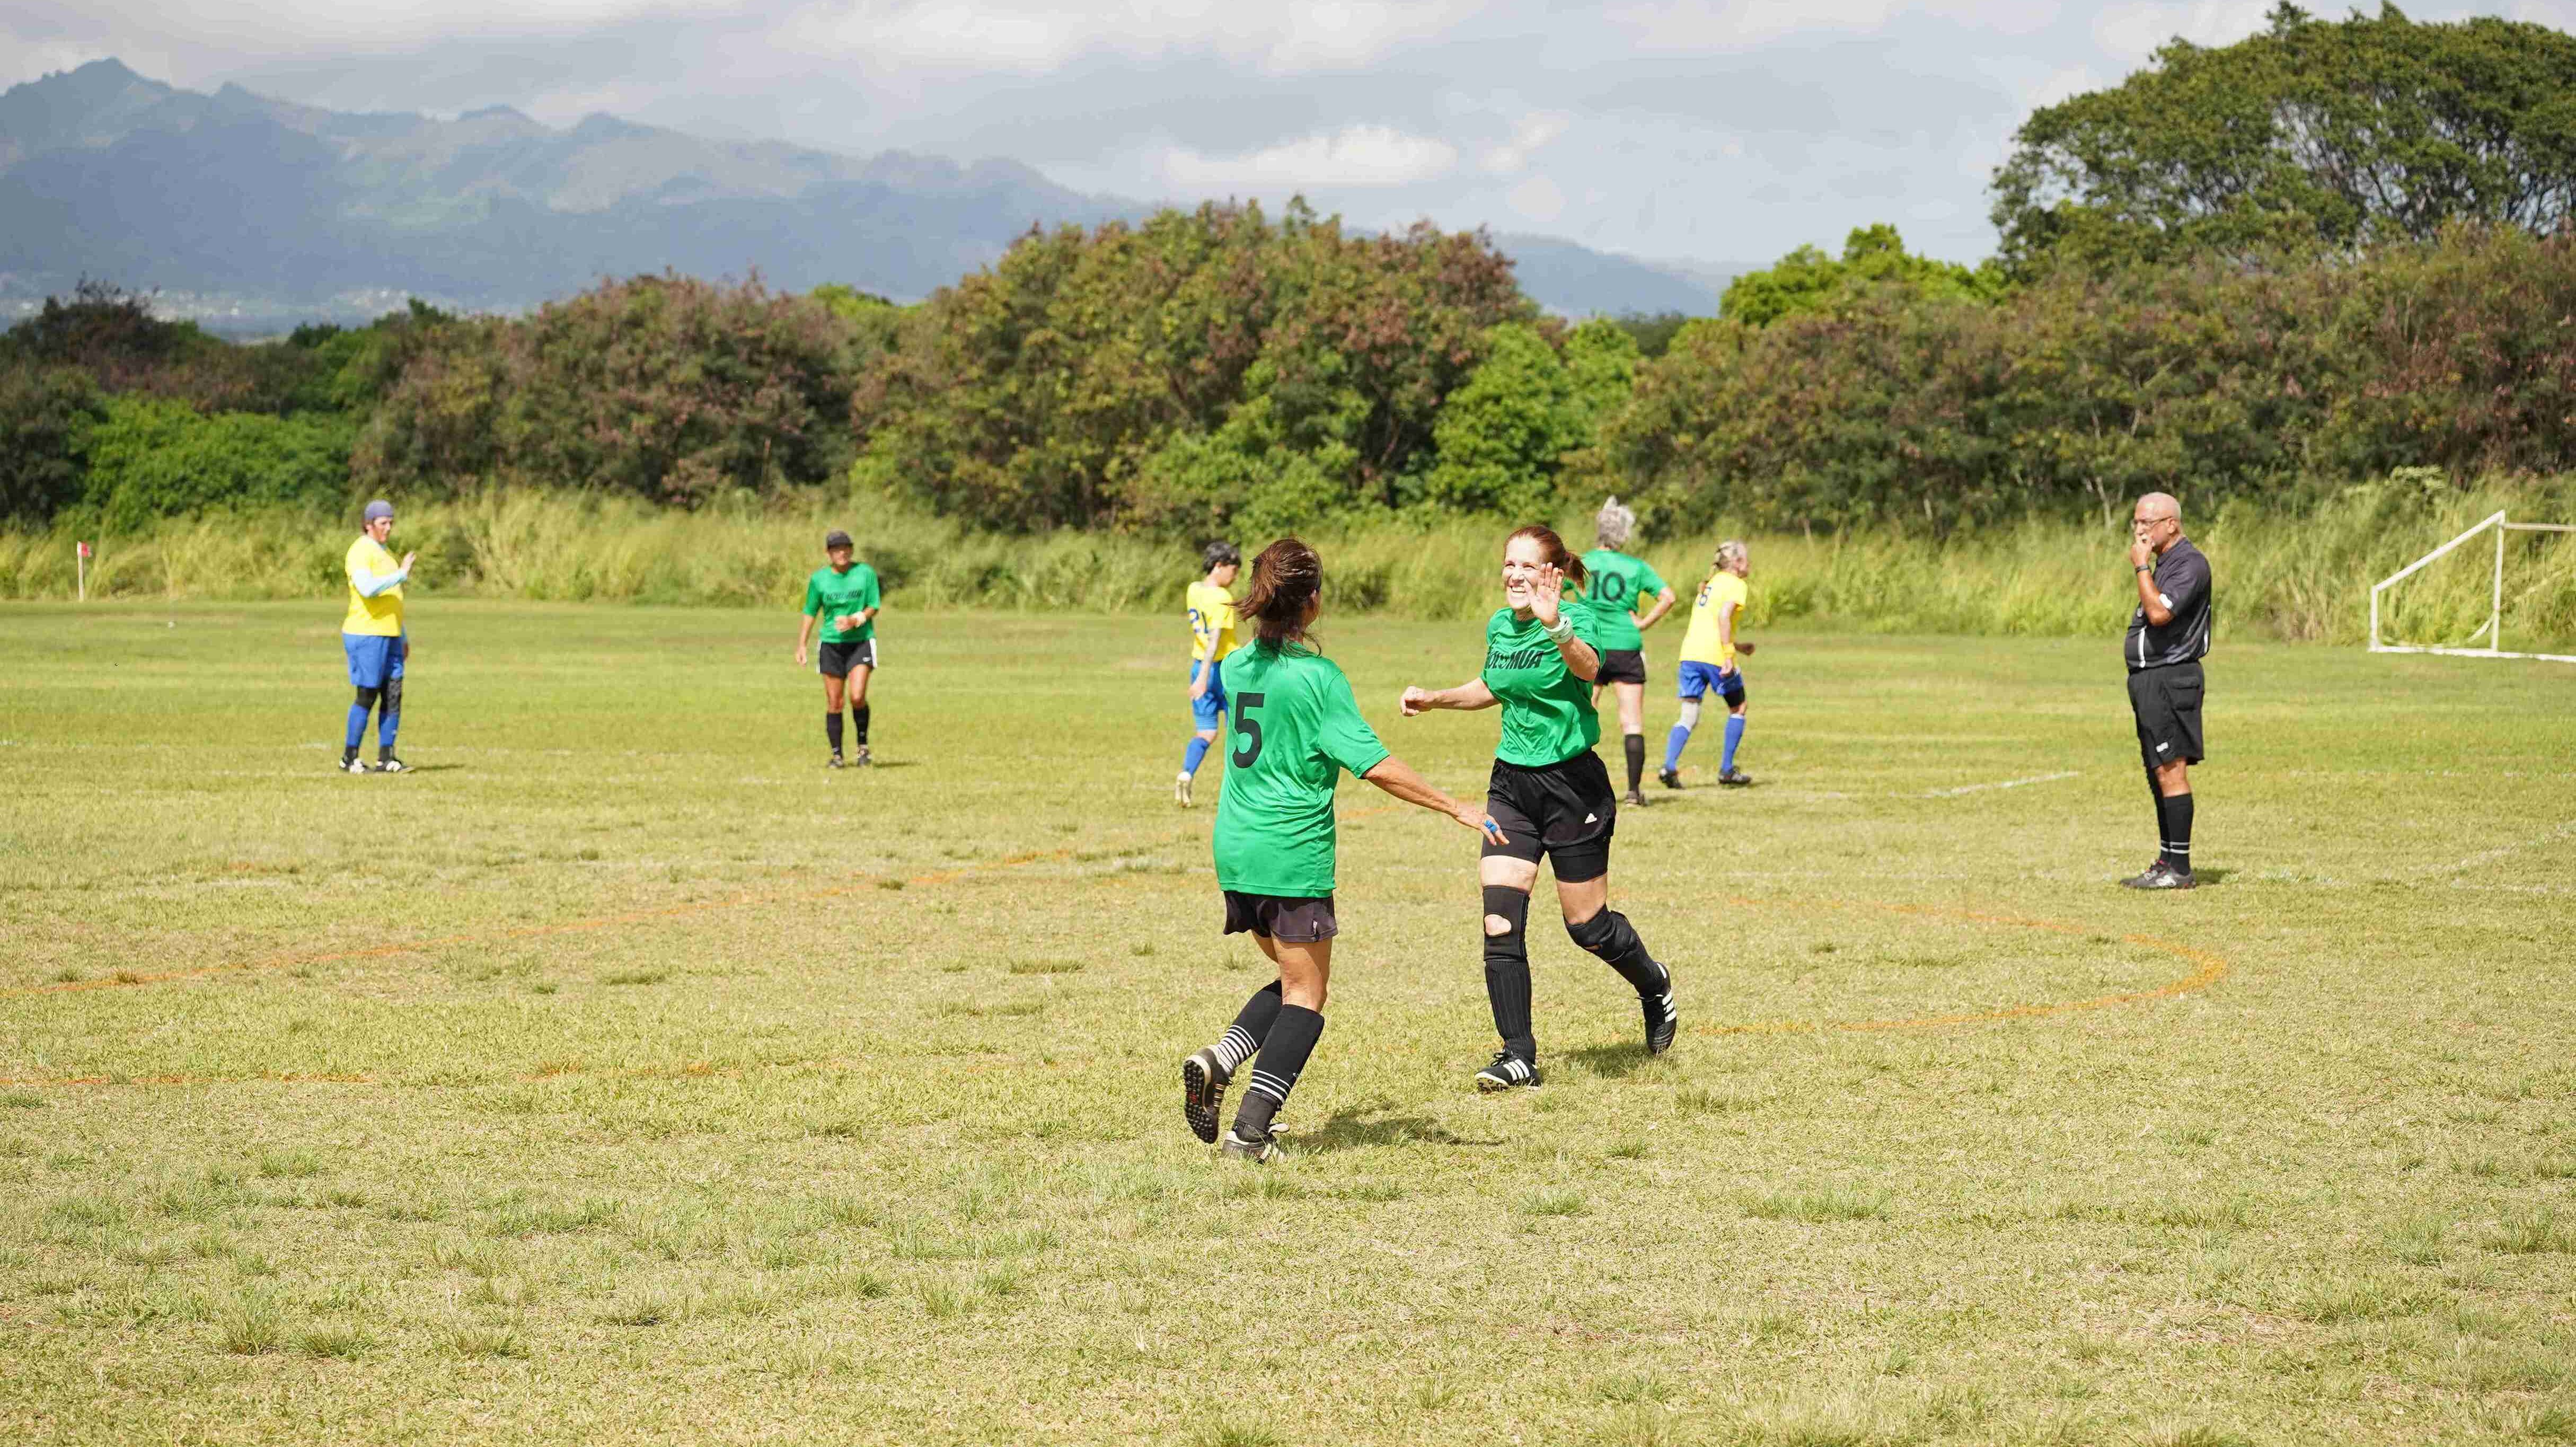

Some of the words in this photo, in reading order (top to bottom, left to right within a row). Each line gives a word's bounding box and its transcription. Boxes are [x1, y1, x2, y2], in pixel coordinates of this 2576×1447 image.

[1590, 570, 1626, 602] 10
[1187, 608, 1209, 634] 21
[1232, 692, 1265, 769] 5
